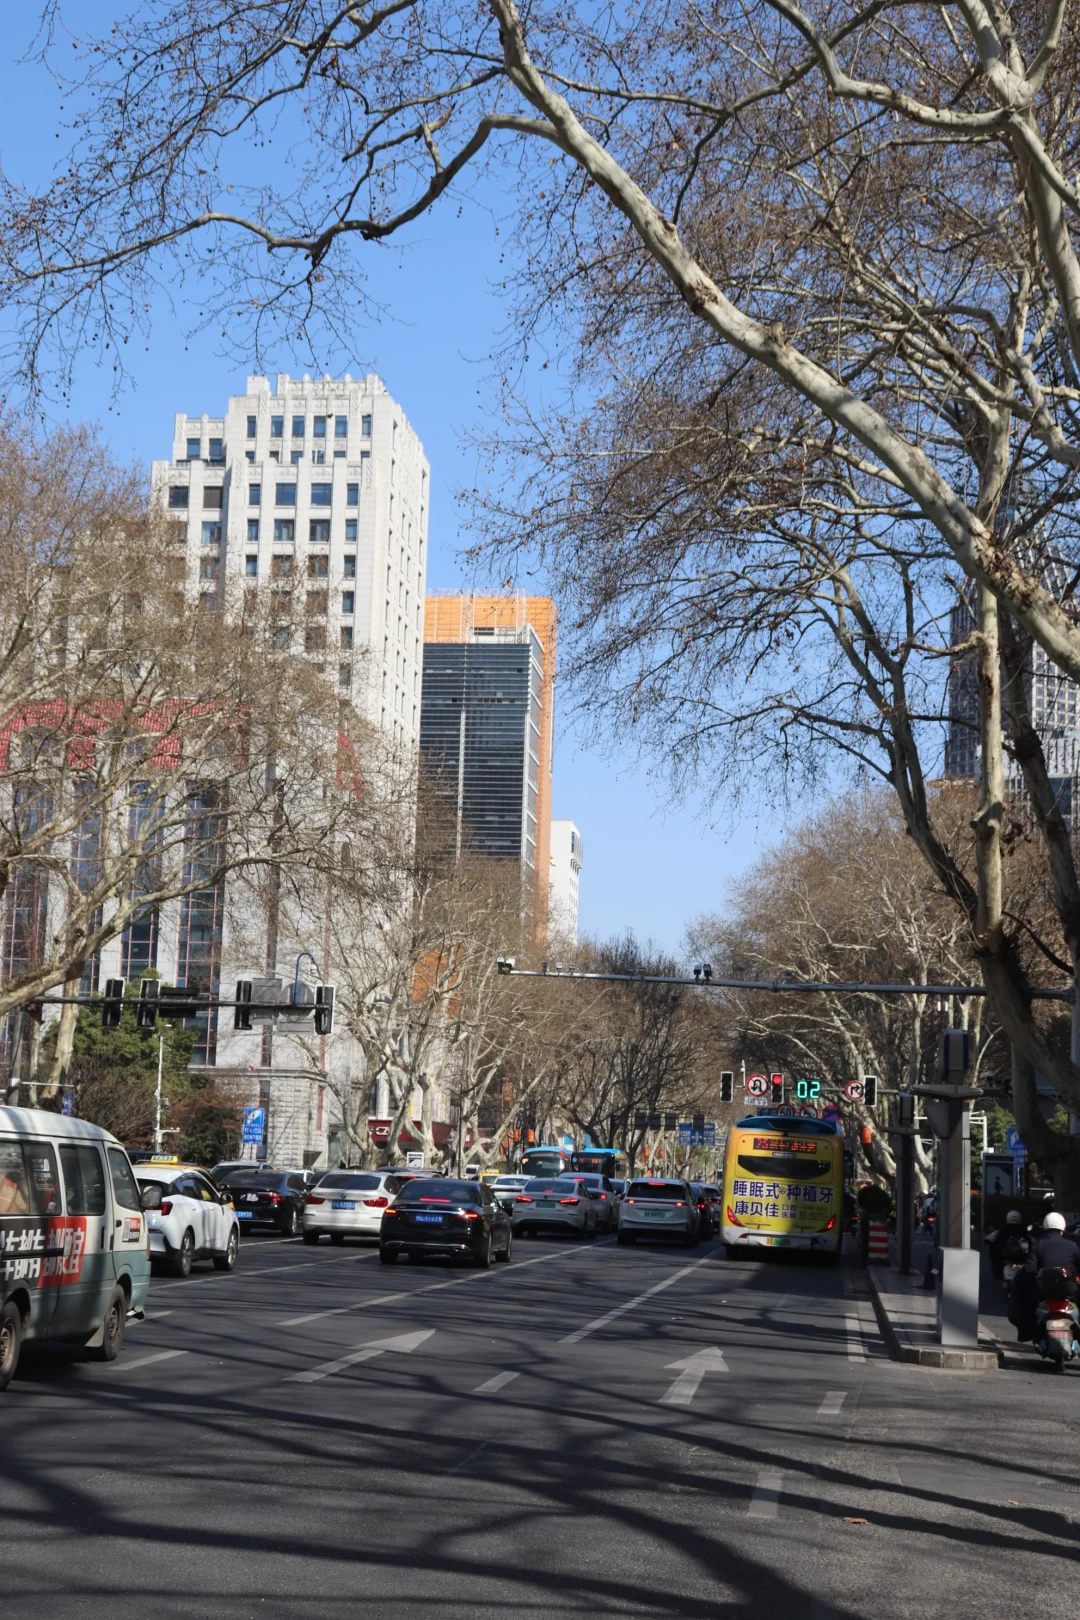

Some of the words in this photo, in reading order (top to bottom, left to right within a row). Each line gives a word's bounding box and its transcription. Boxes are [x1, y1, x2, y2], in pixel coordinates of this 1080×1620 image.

[797, 1080, 820, 1099] 02
[781, 1106, 792, 1117] 60
[733, 1180, 780, 1200] 睡眠式
[786, 1183, 834, 1204] 种植牙
[734, 1200, 780, 1218] 康贝佳
